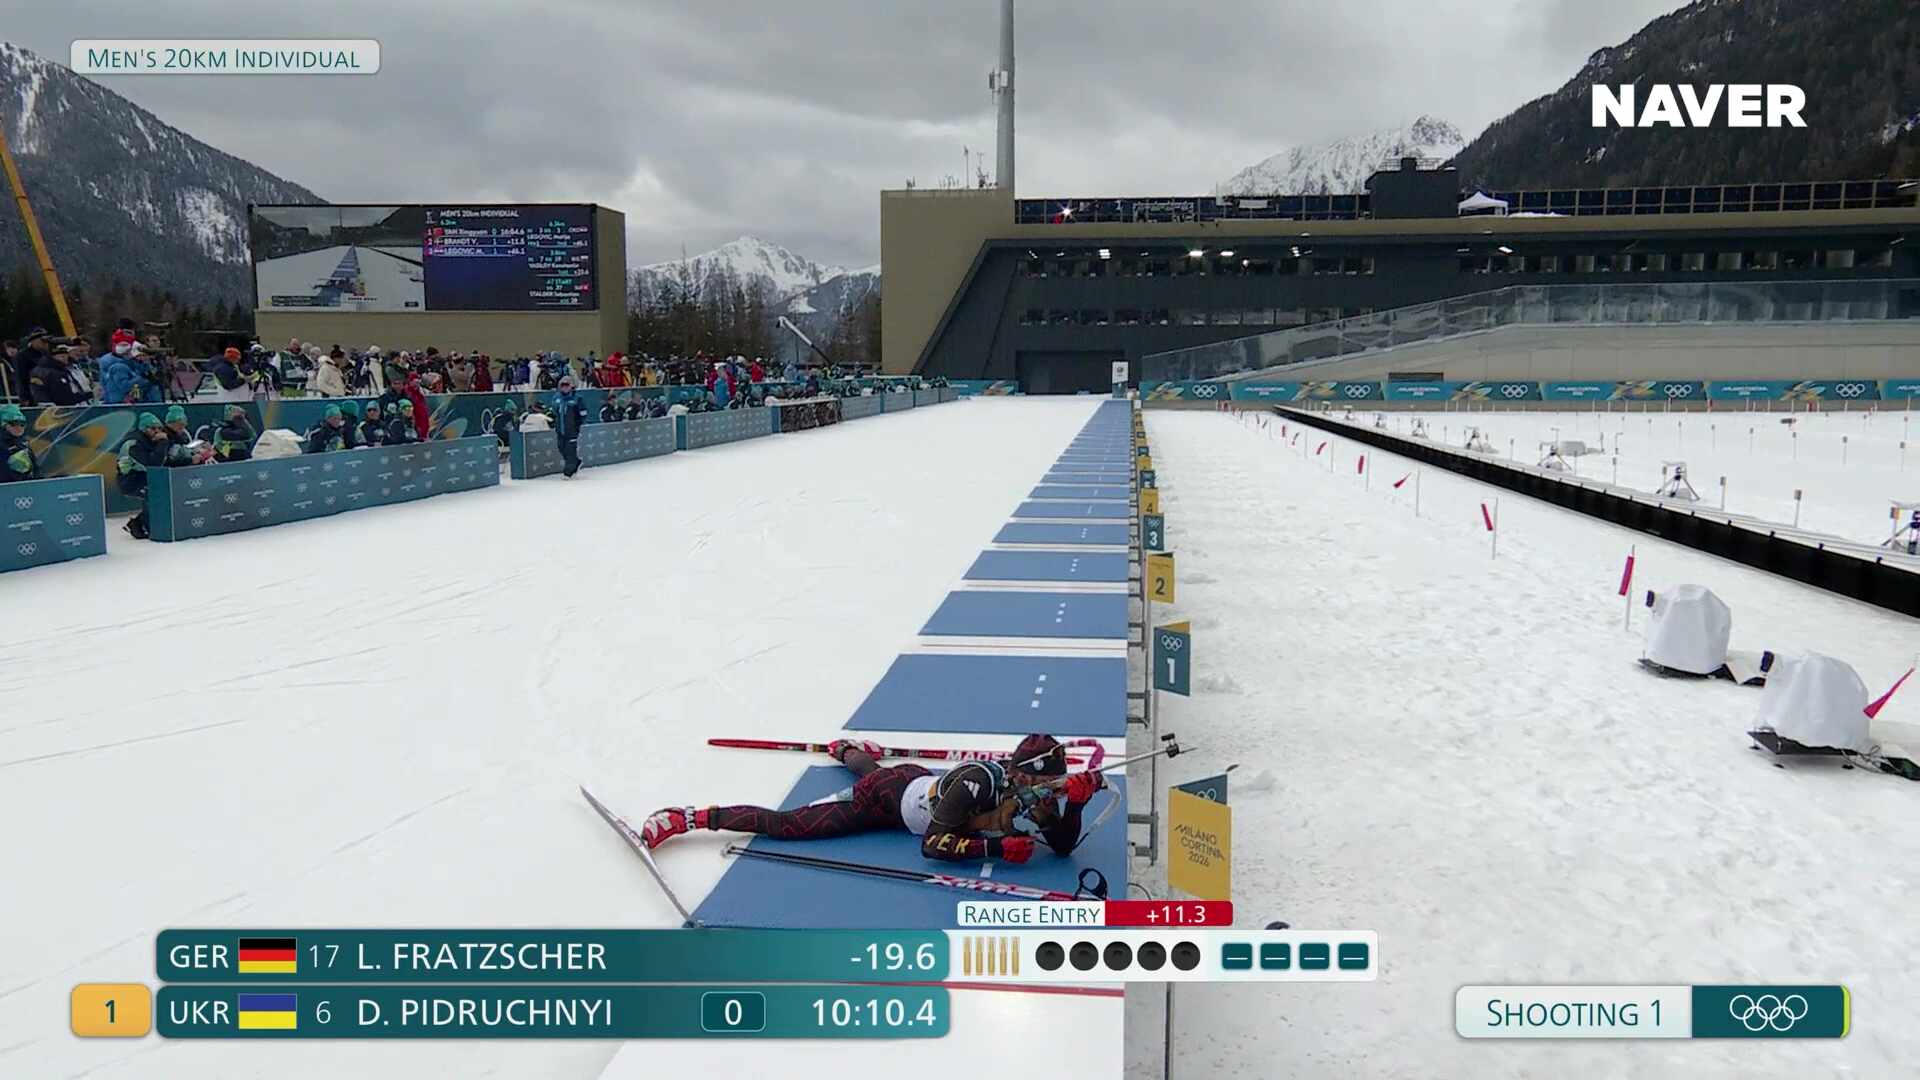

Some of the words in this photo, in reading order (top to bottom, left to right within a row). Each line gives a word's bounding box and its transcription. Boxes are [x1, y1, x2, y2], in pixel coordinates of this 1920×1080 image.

[480, 209, 520, 217] INDIVIDUAL
[1149, 531, 1159, 548] 3
[1155, 577, 1167, 596] 2
[1166, 657, 1176, 685] 1
[1174, 824, 1218, 846] MILANO
[1180, 837, 1226, 862] CORTINA
[1187, 850, 1211, 868] 2026
